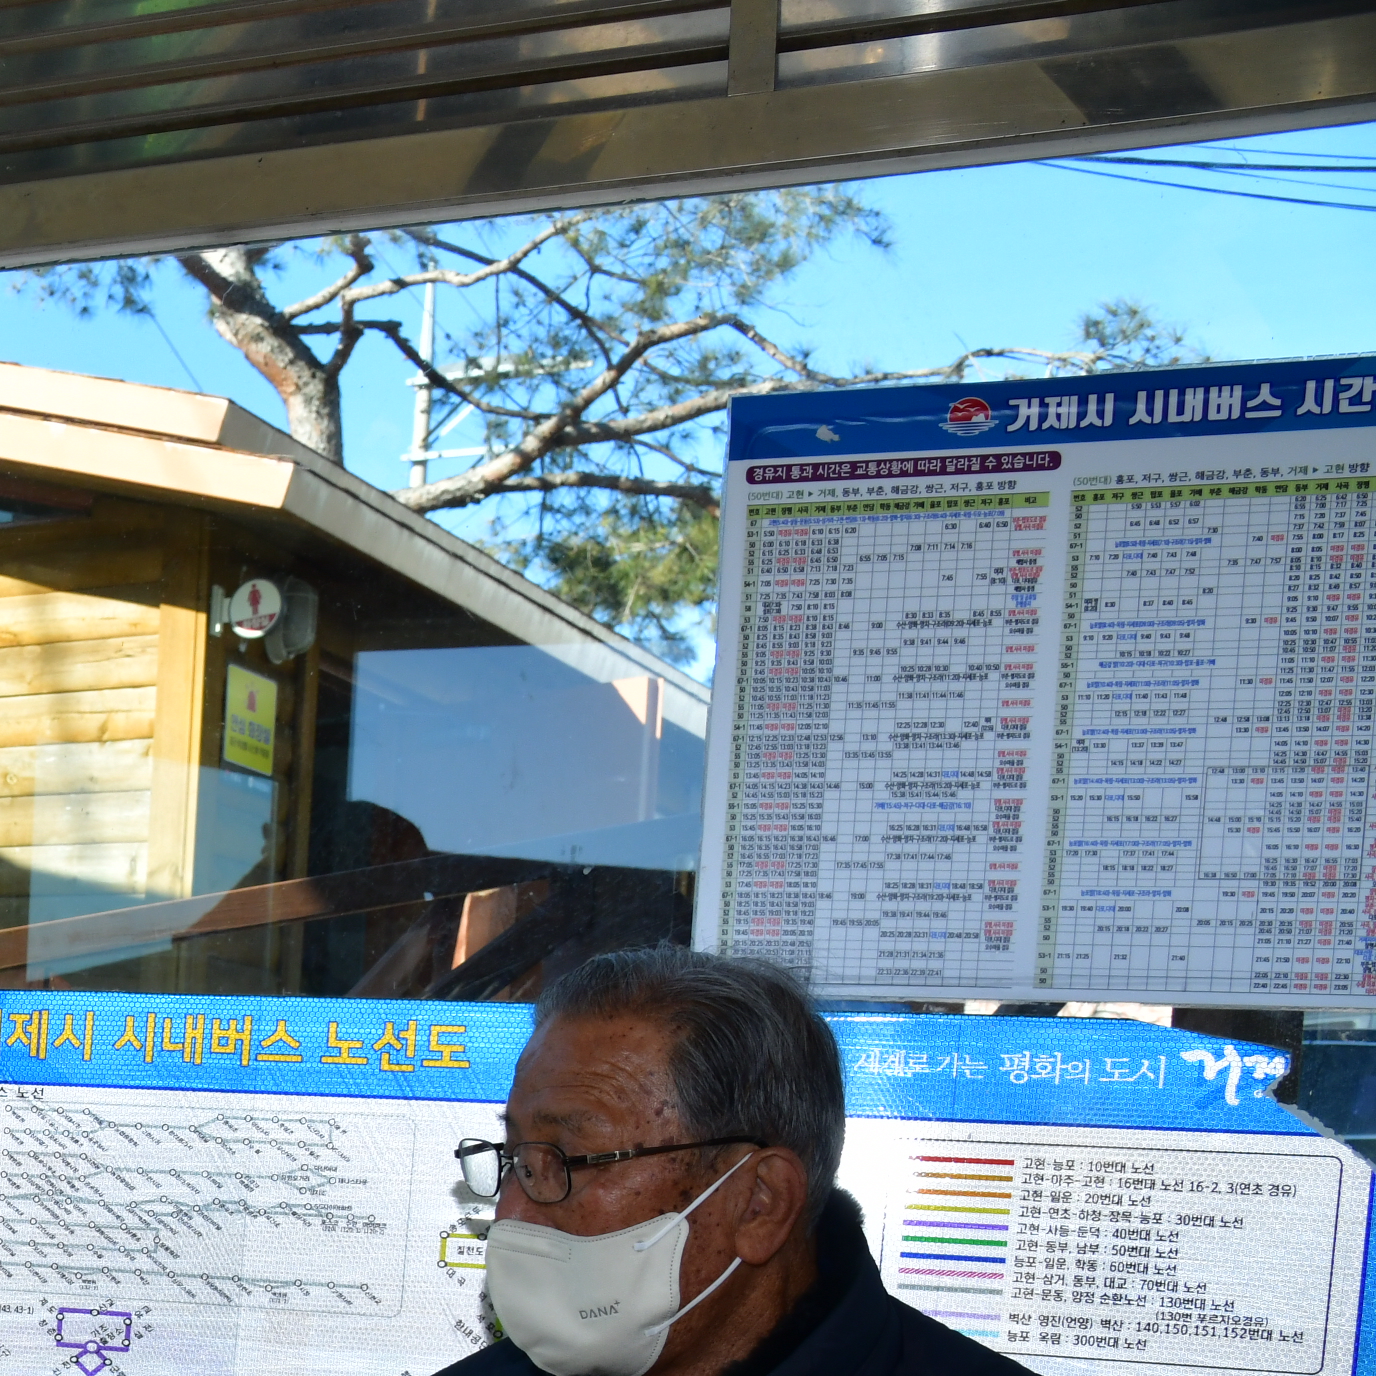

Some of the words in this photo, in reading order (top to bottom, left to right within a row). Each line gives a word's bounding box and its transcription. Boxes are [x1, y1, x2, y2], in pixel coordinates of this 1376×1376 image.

[1006, 391, 1115, 433] 거제시
[1128, 382, 1282, 425] 시내버스
[752, 466, 787, 481] 경유지
[789, 464, 814, 479] 통과
[816, 463, 852, 478] 시간은
[854, 460, 914, 476] 교통상황에
[917, 458, 942, 473] 따라
[945, 457, 981, 472] 달라질
[984, 456, 998, 470] 수
[1001, 453, 1054, 469] 있습니다.
[1072, 474, 1112, 487] (50번대)
[1259, 466, 1284, 479] 동부,
[1287, 464, 1310, 477] 거제
[1323, 462, 1346, 475] 고현
[1348, 461, 1371, 474] 방향
[747, 490, 784, 502] (50번대)
[785, 489, 805, 500] 고현
[817, 486, 838, 499] 거제,
[841, 485, 863, 498] 동부,
[997, 479, 1018, 491] 방향
[113, 1012, 305, 1067] 시내버스
[319, 1019, 471, 1072] 노선도
[936, 1051, 989, 1079] 가는
[999, 1050, 1091, 1085] 평화의
[1100, 1055, 1166, 1088] 도시
[16, 1086, 45, 1100] 노선
[1088, 1161, 1126, 1174] 10번대
[1131, 1162, 1155, 1175] 노선
[1118, 1177, 1156, 1191] 16번대
[1159, 1179, 1184, 1192] 노선
[1189, 1180, 1222, 1194] 16-2,
[1268, 1183, 1297, 1197] 경유)
[1084, 1193, 1123, 1207] 20번대
[1128, 1195, 1152, 1208] 노선
[1175, 1214, 1215, 1228] 30번대
[1219, 1216, 1244, 1229] 노선
[1112, 1228, 1151, 1241] 40번대
[1154, 1230, 1179, 1243] 노선
[1076, 1242, 1100, 1255] 남부
[1111, 1245, 1150, 1258] 50번대
[1154, 1246, 1179, 1259] 노선
[1075, 1259, 1098, 1272] 학동
[1109, 1261, 1149, 1274] 60번대
[1152, 1263, 1177, 1276] 노선
[1103, 1276, 1127, 1290] 대교
[1139, 1279, 1179, 1293] 70번대
[1183, 1282, 1207, 1294] 노선
[1071, 1290, 1095, 1304] 양정
[1099, 1292, 1147, 1307] 순환노선
[1159, 1297, 1206, 1311] 130번대
[1210, 1299, 1235, 1312] 노선
[1073, 1334, 1119, 1349] 300번대
[1123, 1338, 1147, 1350] 노선
[1278, 1330, 1304, 1344] 노선
